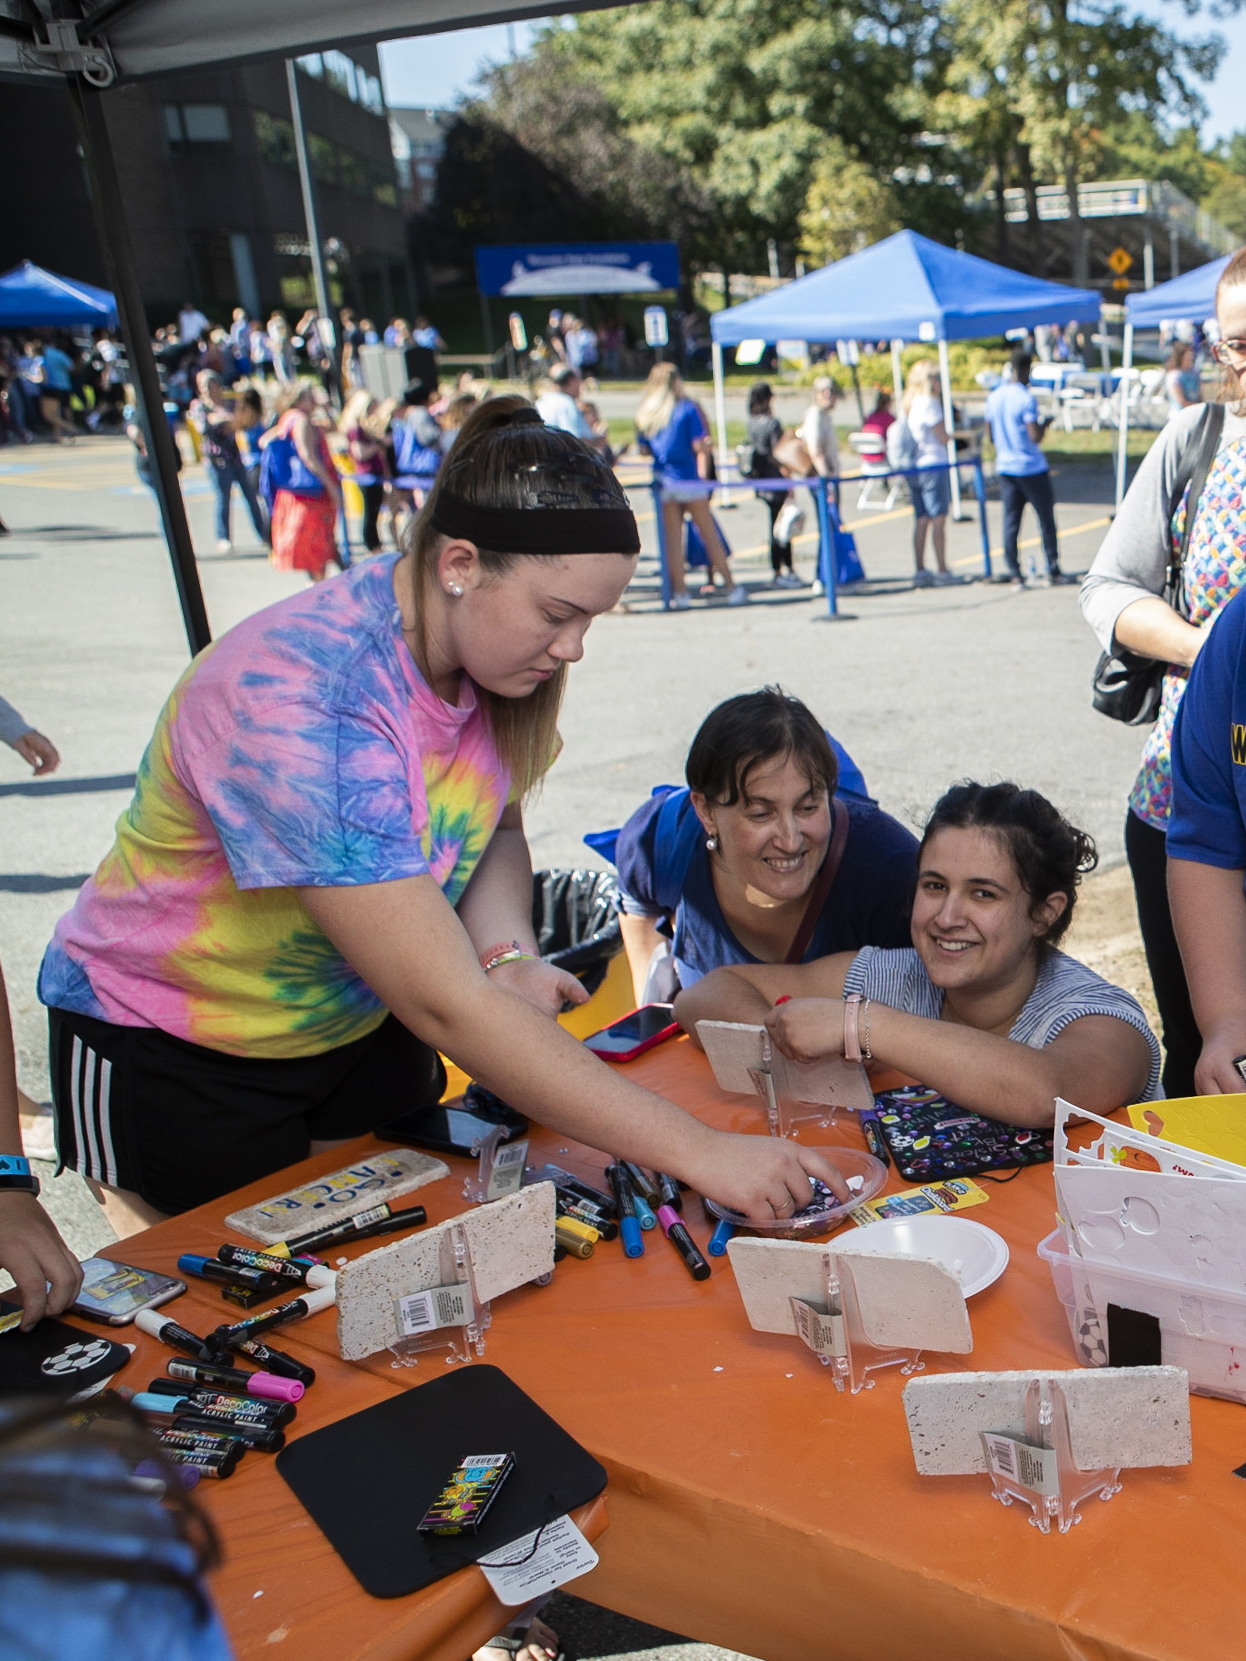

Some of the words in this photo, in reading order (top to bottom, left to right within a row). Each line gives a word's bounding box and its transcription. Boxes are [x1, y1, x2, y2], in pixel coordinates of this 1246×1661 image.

[231, 1251, 283, 1273] DecoColor
[216, 1395, 268, 1415] DecoColor
[201, 1409, 232, 1420] ACRYLIC
[234, 1413, 258, 1424] PAINT
